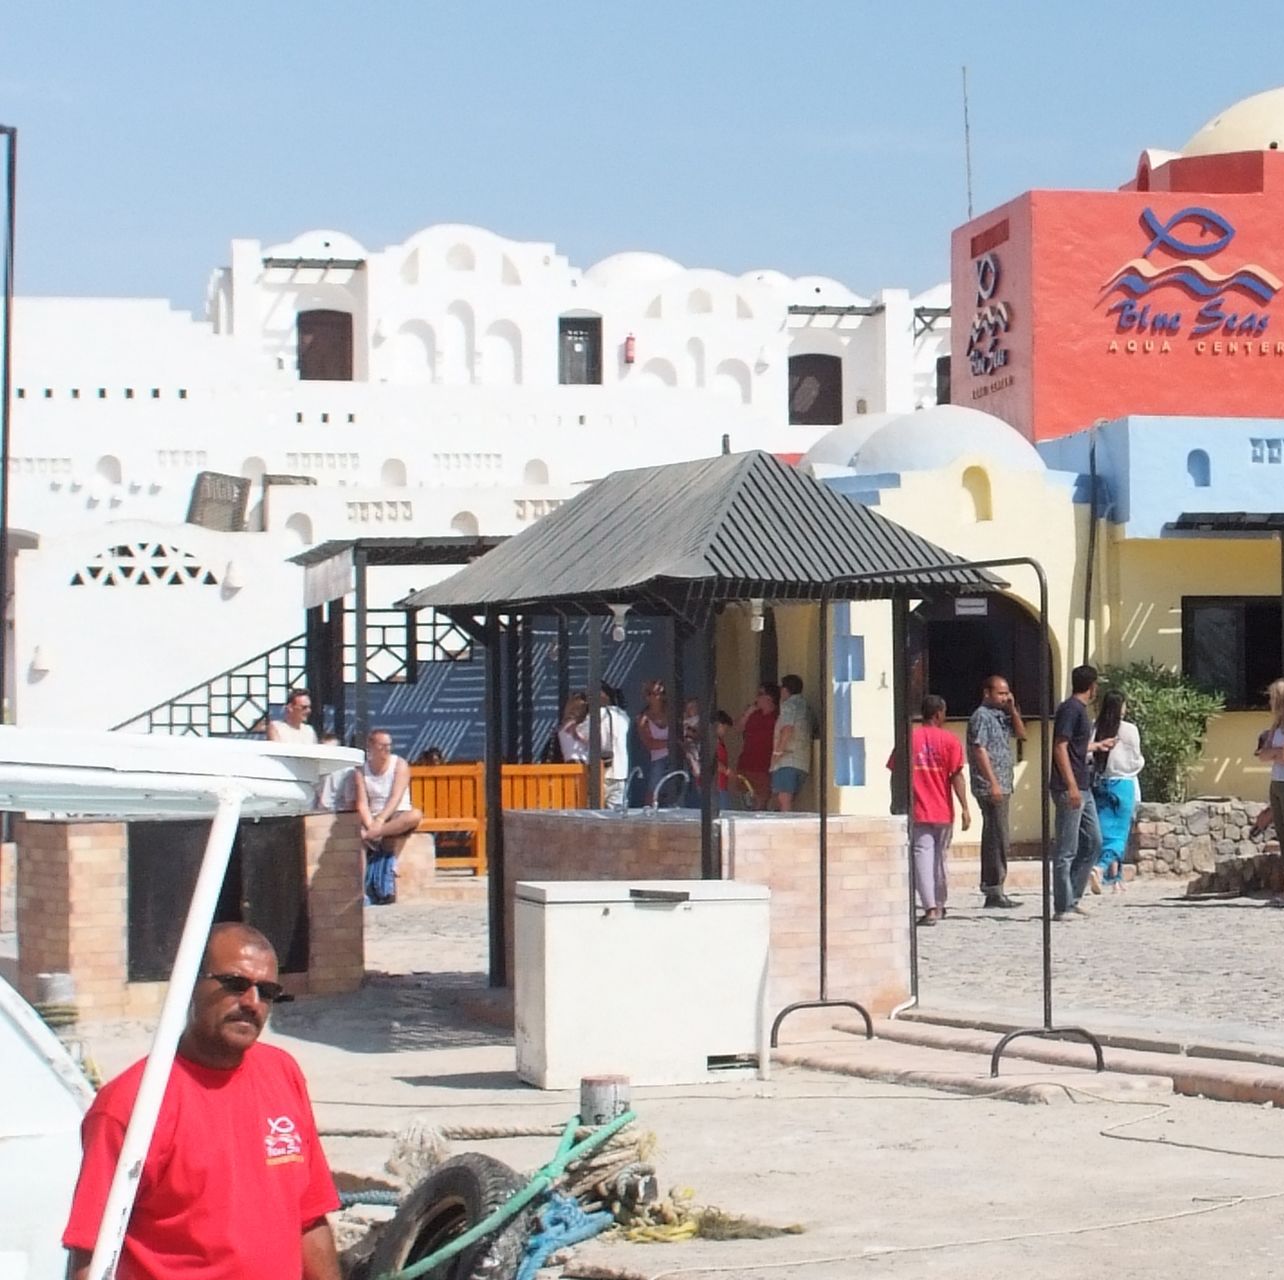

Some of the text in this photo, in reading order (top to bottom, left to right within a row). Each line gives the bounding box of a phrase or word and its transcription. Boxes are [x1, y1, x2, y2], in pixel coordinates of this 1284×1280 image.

[1109, 297, 1270, 334] Blue Seas
[1109, 339, 1172, 353] AQUA
